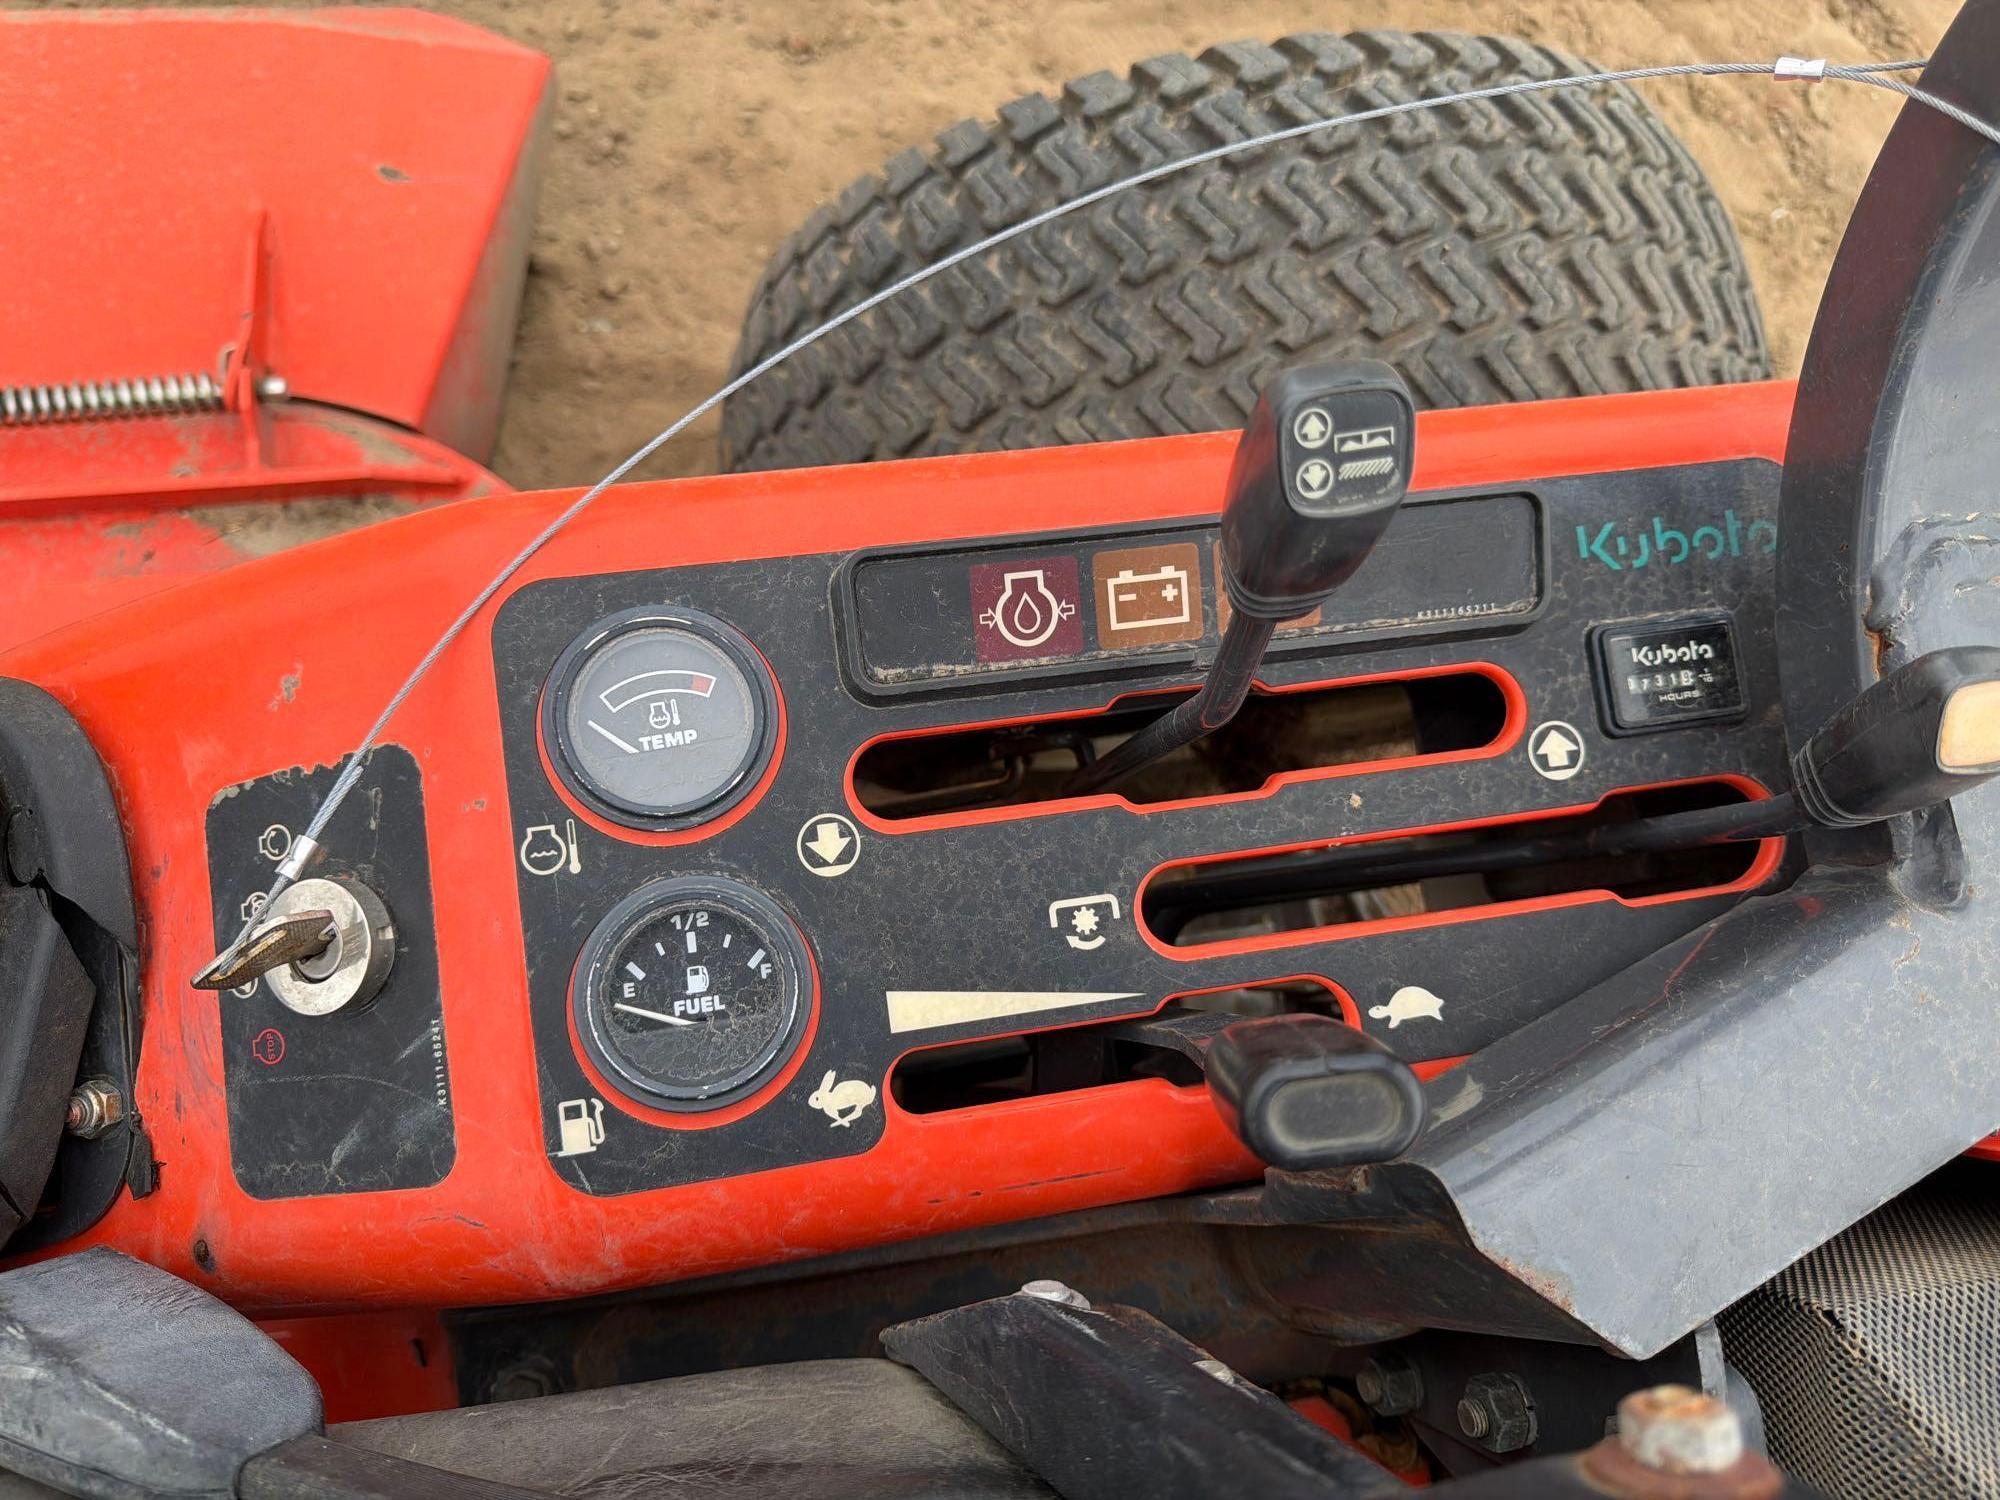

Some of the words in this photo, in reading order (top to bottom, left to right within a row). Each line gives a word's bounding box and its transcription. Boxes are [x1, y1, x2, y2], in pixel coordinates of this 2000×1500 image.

[1576, 509, 1777, 570] Kubota
[1631, 640, 1714, 666] Kubota
[1659, 690, 1701, 702] HOURS
[638, 729, 698, 751] TEMP
[670, 911, 709, 931] 1/2
[760, 963, 772, 979] F
[623, 982, 636, 998] E
[673, 995, 725, 1017] FUEL
[266, 1033, 275, 1060] STOP
